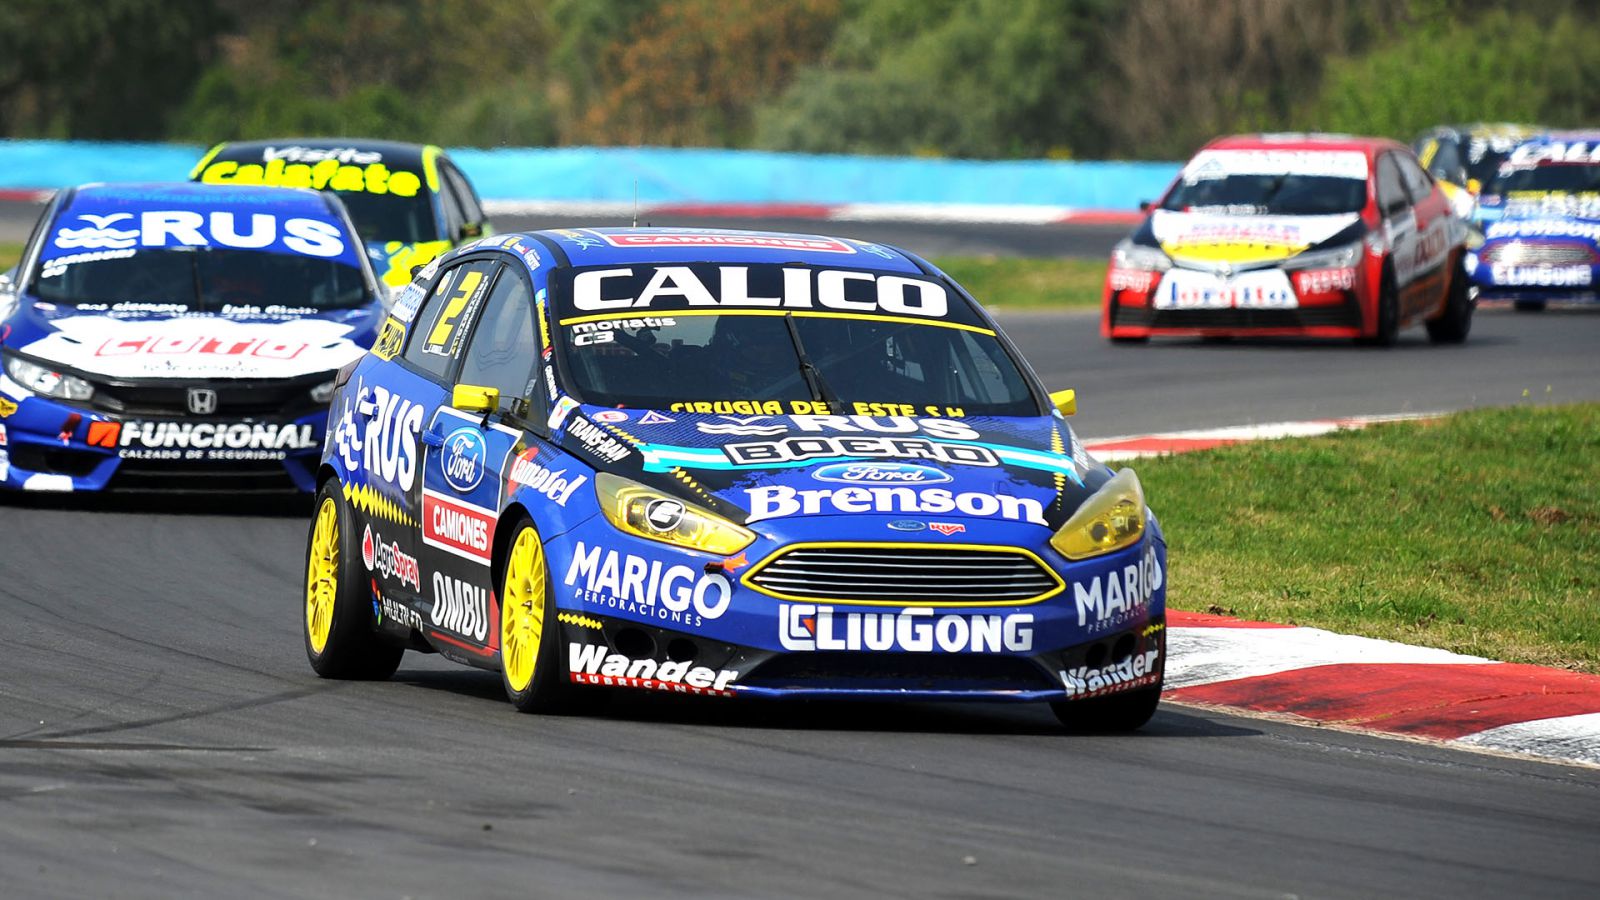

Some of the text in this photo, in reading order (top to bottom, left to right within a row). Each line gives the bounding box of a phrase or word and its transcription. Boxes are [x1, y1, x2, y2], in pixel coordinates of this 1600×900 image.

[142, 211, 344, 257] RUS
[626, 236, 832, 249] CAMIONES
[428, 271, 483, 345] 2
[573, 266, 948, 317] CALICO
[572, 317, 676, 334] moriatis
[575, 330, 614, 346] C3
[789, 414, 981, 440] RUS
[853, 402, 918, 417] ESTE
[118, 449, 181, 460] CALZADO
[208, 450, 287, 460] SEGURIDAD
[119, 422, 318, 449] FUNCIONAL
[364, 385, 424, 492] RUS
[567, 415, 632, 462] TRANS-BAN
[726, 437, 997, 466] BOERO
[447, 434, 479, 484] Ford
[842, 464, 925, 482] Ford
[433, 505, 488, 552] CAMIONES
[743, 485, 1049, 526] Brenson
[375, 532, 420, 593] AgroSpray
[564, 541, 732, 620] MARIGO
[430, 571, 488, 641] OMBU
[575, 588, 703, 627] PERFORACIONES
[1073, 546, 1162, 627] MARIGO
[569, 642, 739, 692] Wander
[1059, 650, 1159, 696] Wander
